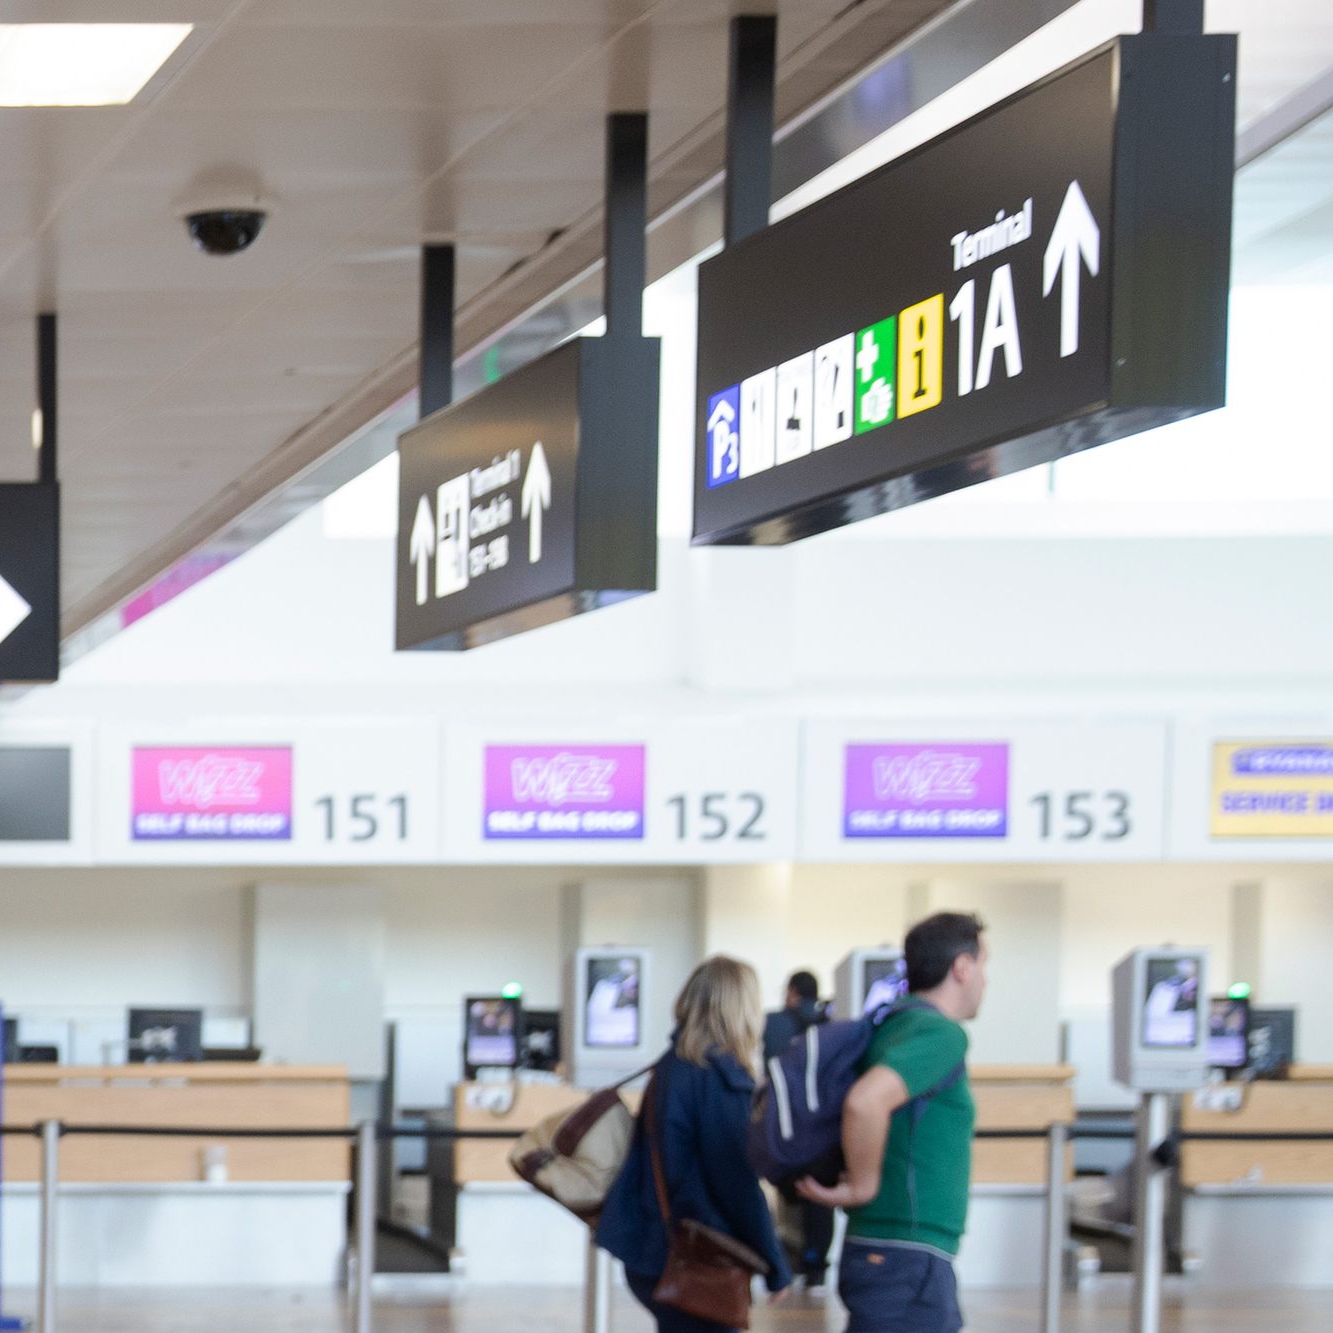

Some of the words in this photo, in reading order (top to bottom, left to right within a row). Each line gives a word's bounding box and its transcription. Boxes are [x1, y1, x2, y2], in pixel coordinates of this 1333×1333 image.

[950, 197, 1033, 271] Terminal
[949, 263, 1023, 397] 1A
[314, 793, 410, 842] 151
[666, 791, 767, 841] 152
[1030, 790, 1133, 841] 153
